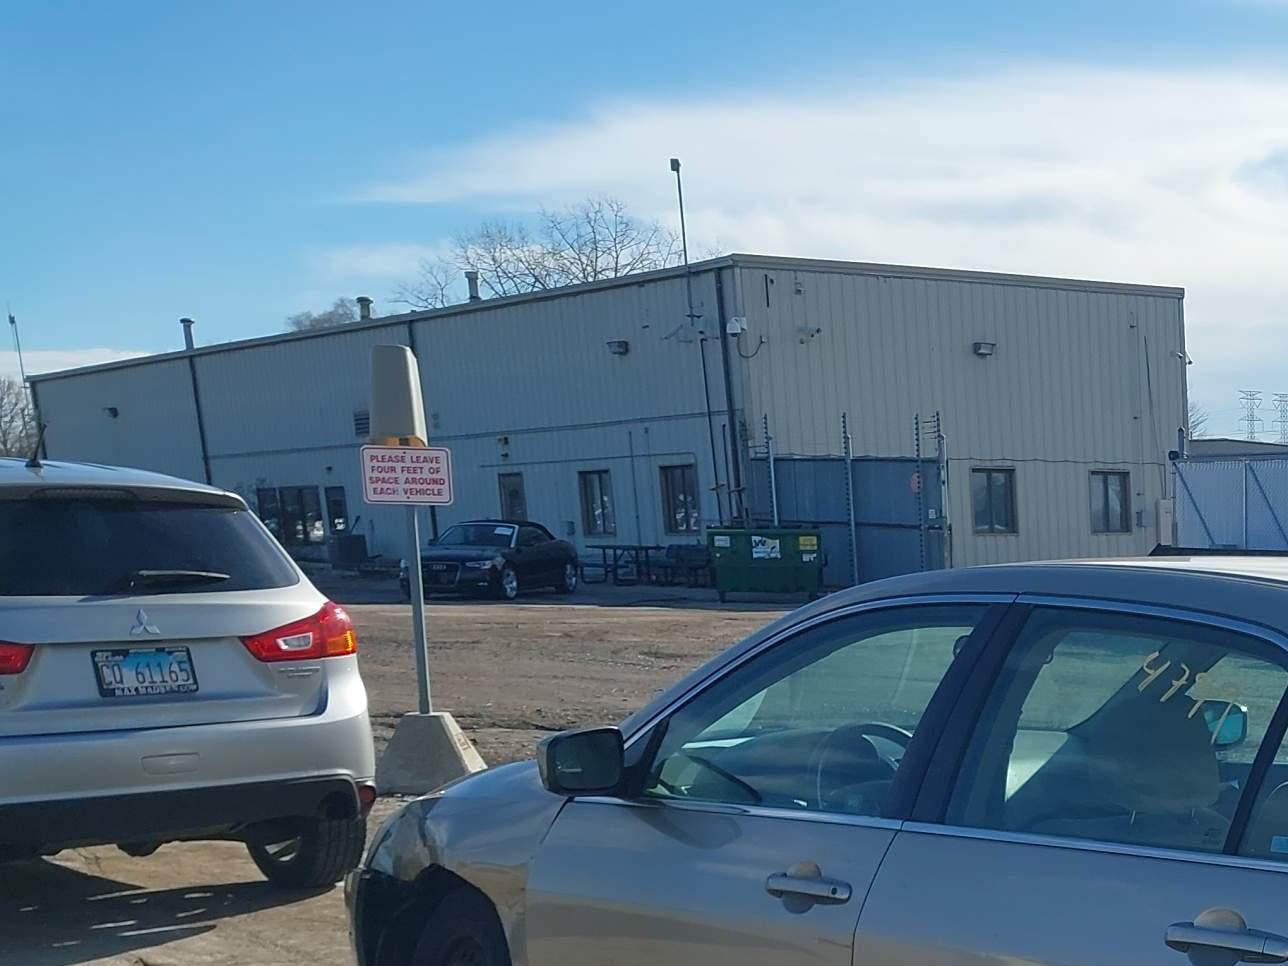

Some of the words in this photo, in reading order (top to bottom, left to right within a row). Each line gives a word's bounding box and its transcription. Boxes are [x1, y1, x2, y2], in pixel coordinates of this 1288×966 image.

[370, 455, 406, 463] PLEASE
[411, 456, 441, 464] LEAVE
[371, 466, 397, 474] FOUR
[401, 466, 424, 474] FEET
[428, 467, 441, 475] OF
[369, 476, 400, 485] SPACE
[404, 477, 446, 485] AROUND
[373, 487, 399, 495] EACH
[403, 488, 443, 496] VEHICLE
[135, 661, 190, 684] 61165
